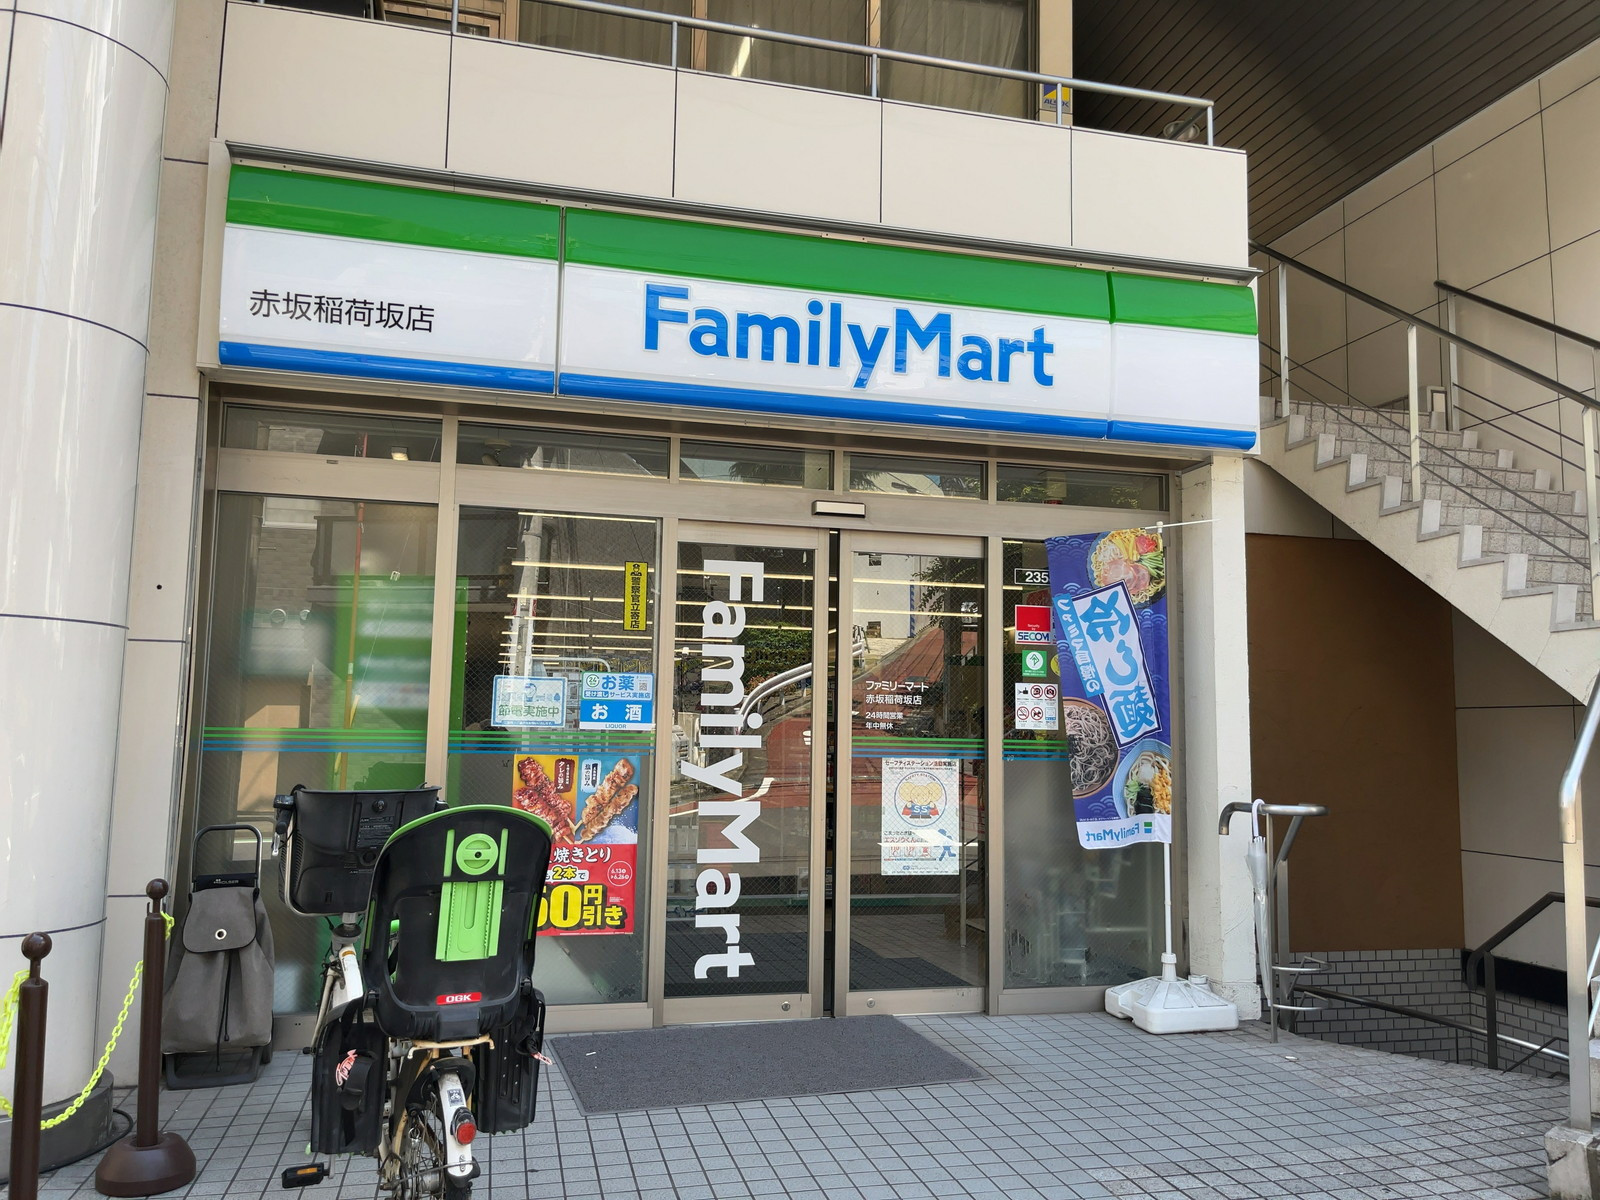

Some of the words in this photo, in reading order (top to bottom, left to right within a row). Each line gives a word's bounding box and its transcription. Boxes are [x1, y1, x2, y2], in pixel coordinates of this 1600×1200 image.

[249, 289, 435, 333] 赤坂稲荷坂店
[643, 282, 1055, 390] FamilyMart
[1025, 571, 1049, 584] 235
[1017, 631, 1050, 642] SECOM
[601, 675, 635, 691] お薬
[865, 680, 929, 693] ファミリーマート
[865, 694, 923, 706] 赤坂稲荷坂店
[498, 704, 560, 718] 節電実施中
[591, 702, 643, 722] お酒
[865, 711, 904, 720] 24時間営業
[865, 721, 894, 730] 年中無休
[680, 559, 765, 980] FamilyMart
[549, 846, 612, 864] 焼きとり
[445, 993, 472, 1003] OGK
